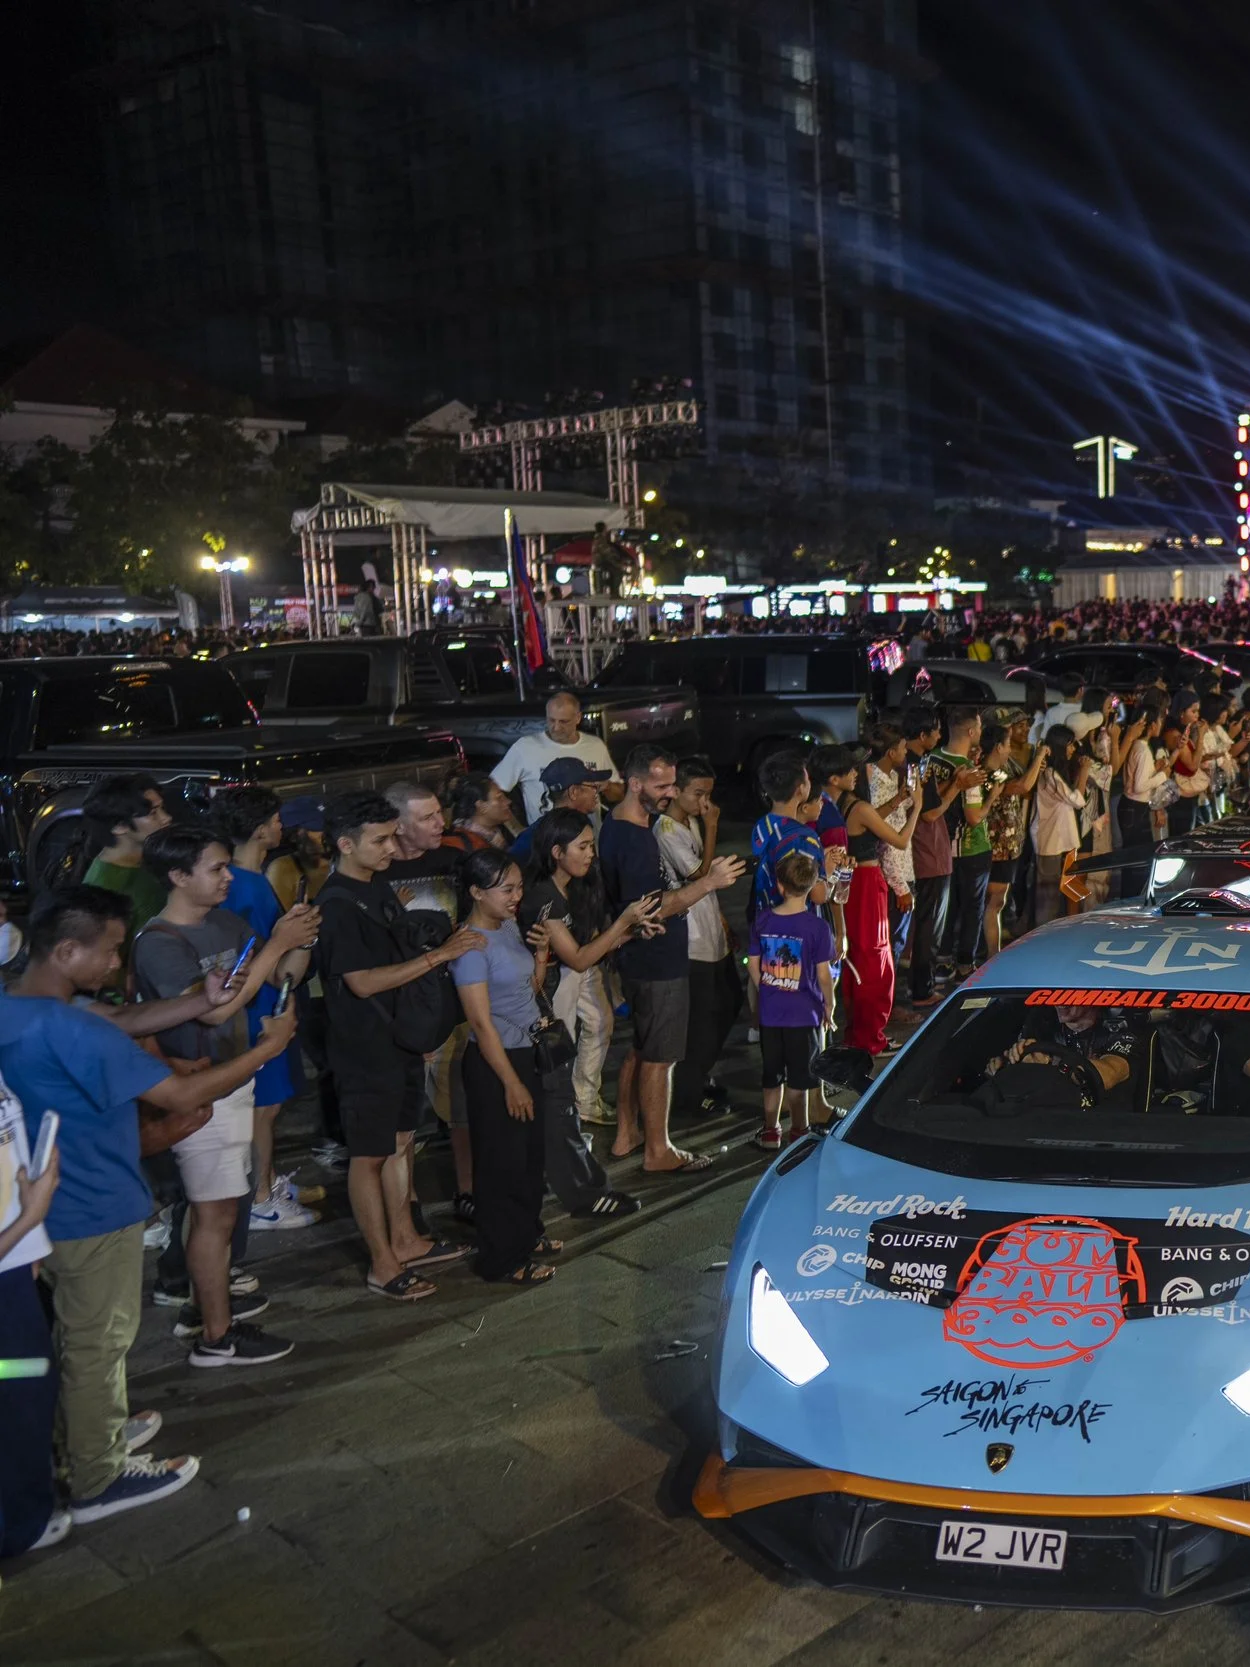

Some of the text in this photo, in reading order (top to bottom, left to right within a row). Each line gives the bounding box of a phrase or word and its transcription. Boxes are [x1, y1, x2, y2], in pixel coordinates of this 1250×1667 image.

[762, 972, 799, 990] MIAMI
[1024, 989, 1167, 1008] GUMBALL
[826, 1194, 903, 1215] Hard
[1165, 1205, 1243, 1229] Hard
[812, 1225, 958, 1249] BANG & OLUFSEN
[842, 1252, 886, 1271] CHIP
[1161, 1247, 1213, 1261] BANG
[1219, 1248, 1231, 1262] &
[892, 1262, 947, 1280] MONG
[786, 1288, 932, 1306] ULYSSE NARDIN
[1153, 1304, 1225, 1317] ULYSSE
[943, 1303, 1125, 1349] 3000
[905, 1374, 1016, 1417] SAIGON
[942, 1399, 1113, 1444] SINGAPORE
[942, 1525, 1062, 1565] W2 JVR
